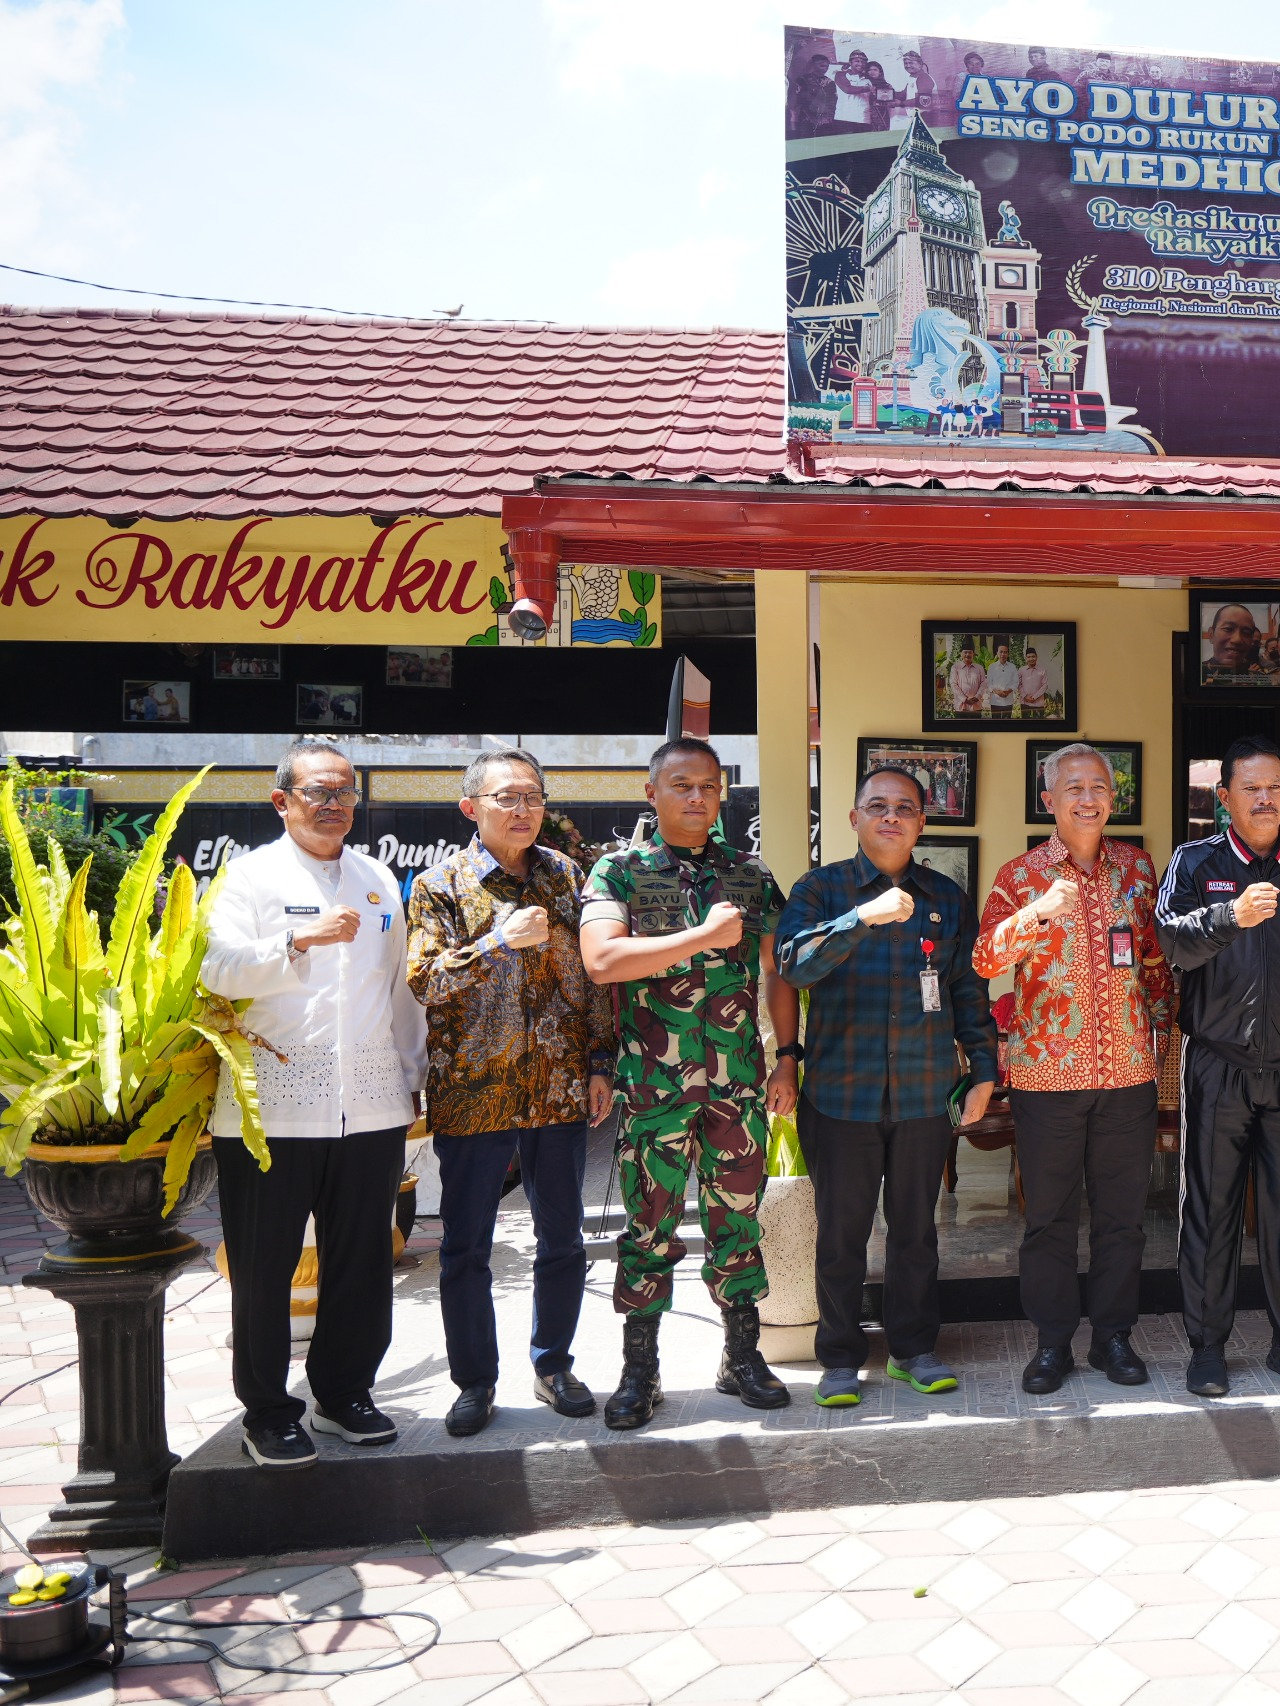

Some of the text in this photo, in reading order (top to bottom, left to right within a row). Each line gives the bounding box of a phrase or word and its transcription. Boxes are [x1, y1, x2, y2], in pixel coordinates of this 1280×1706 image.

[959, 77, 1075, 117] AYO
[961, 116, 1049, 140] SENG
[1058, 122, 1151, 147] PODO
[1159, 129, 1271, 155] RUKUN
[1089, 200, 1258, 232] Prestasiku
[1107, 268, 1156, 288] 310
[1102, 297, 1166, 315] Regional,
[1170, 301, 1227, 315] Nasional
[1230, 304, 1255, 315] dan
[0, 517, 487, 629] k Rakyatku
[639, 894, 680, 906] BAYU
[725, 894, 763, 904] TNI AD
